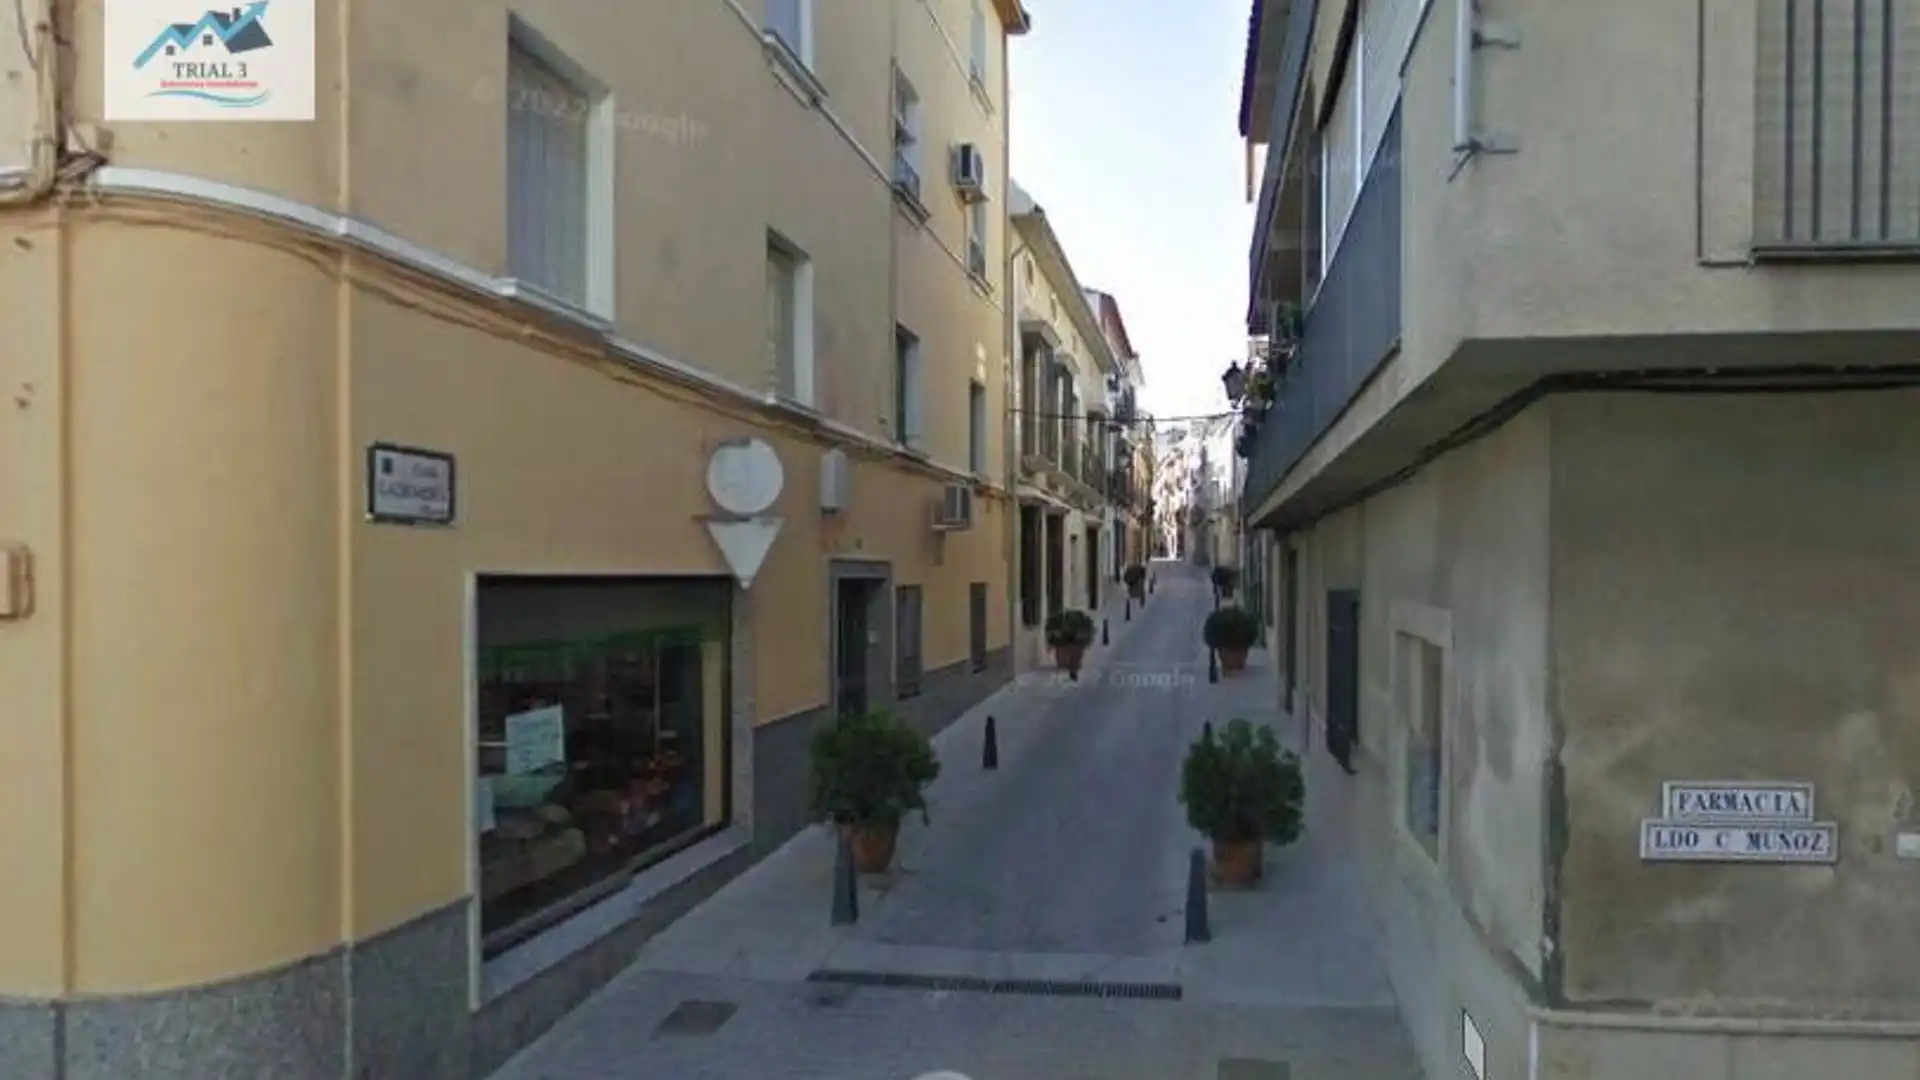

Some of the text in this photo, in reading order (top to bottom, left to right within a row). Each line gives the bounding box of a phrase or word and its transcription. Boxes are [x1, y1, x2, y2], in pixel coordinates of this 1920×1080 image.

[1678, 791, 1801, 813] FARMACIA
[1654, 830, 1700, 849] LDO
[1715, 830, 1731, 848] C
